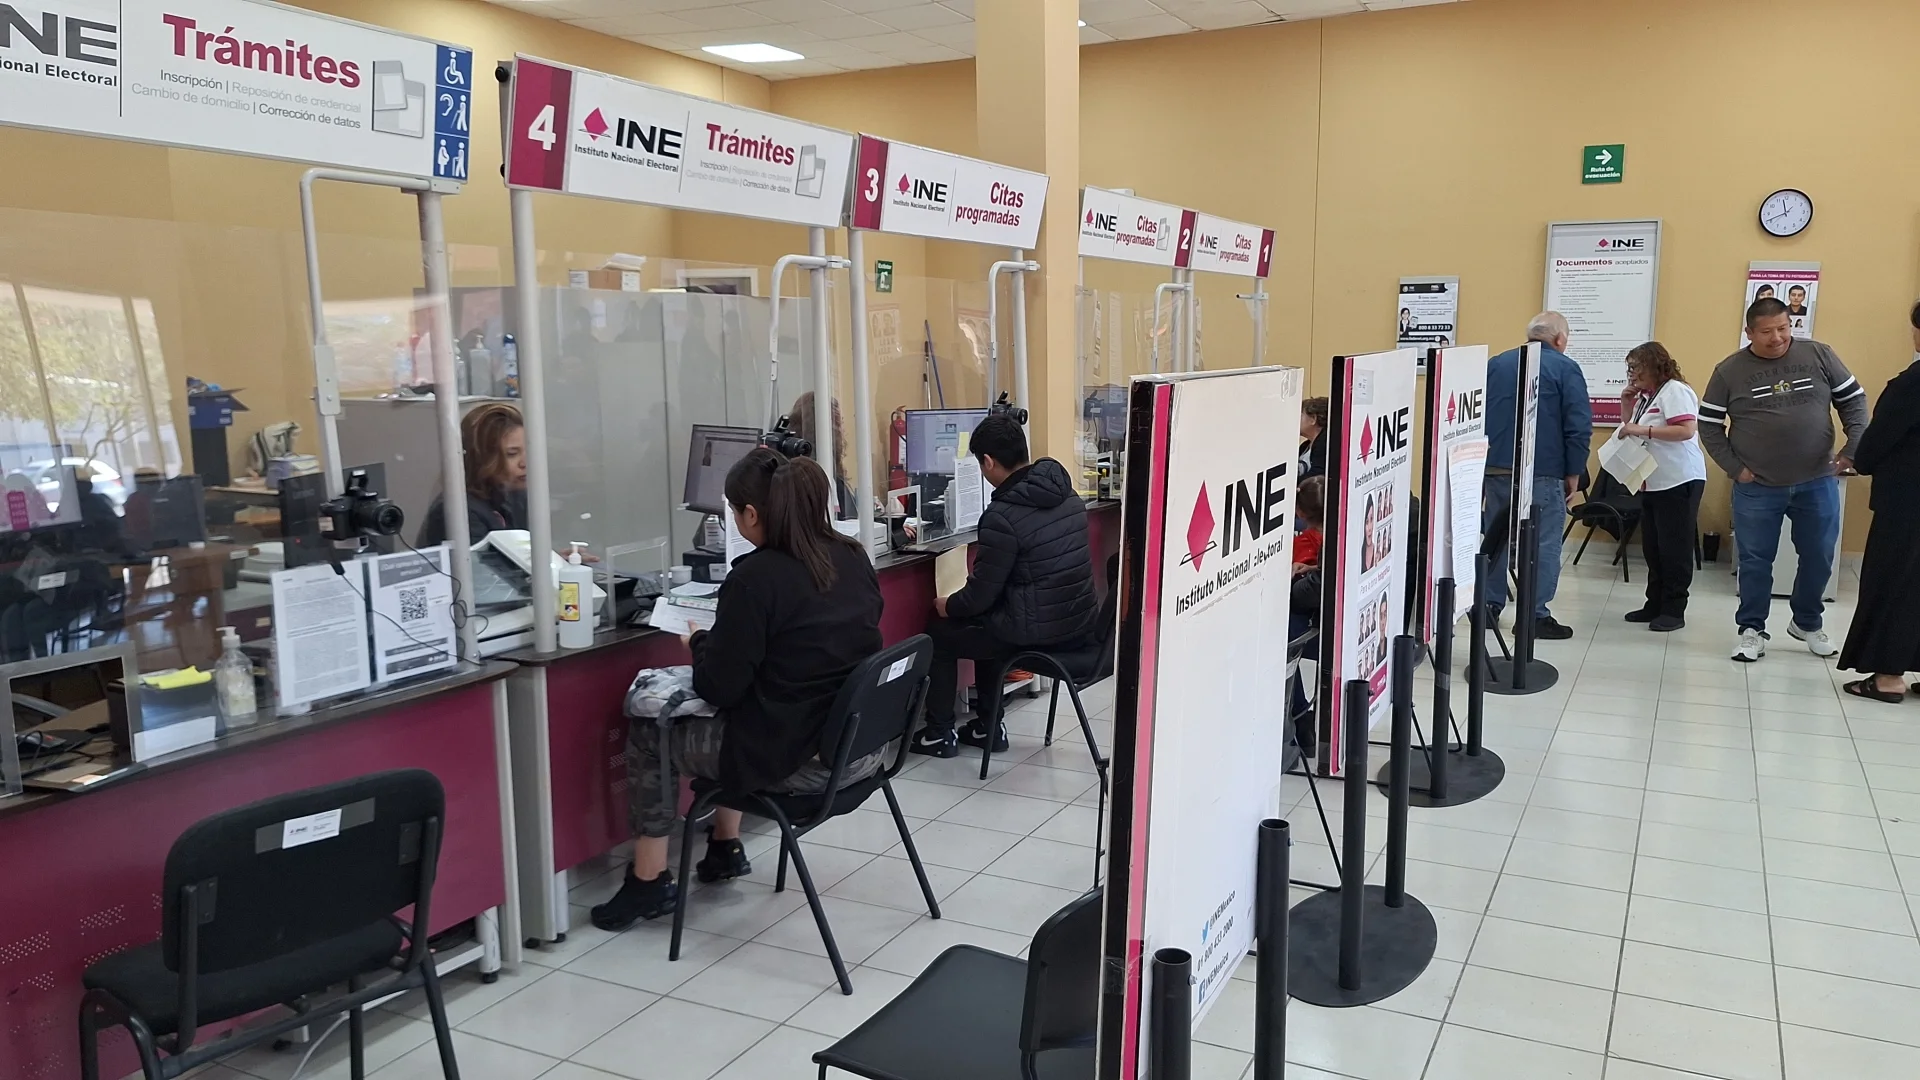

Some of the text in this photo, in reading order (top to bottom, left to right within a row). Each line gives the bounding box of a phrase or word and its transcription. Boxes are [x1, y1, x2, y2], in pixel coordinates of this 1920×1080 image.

[162, 13, 361, 89] Trámites
[45, 63, 117, 87] Electoral
[160, 69, 362, 114] Inscripción Reposición de credencial
[131, 82, 361, 129] Cambio de domicilio Corrección de datos
[528, 104, 557, 151] 4
[616, 117, 683, 160] INE
[706, 122, 796, 166] Trámites
[574, 143, 679, 173] Instituto Nacional Electoral
[864, 167, 880, 202] 3
[912, 178, 948, 203] INE
[990, 181, 1025, 209] Citas
[892, 198, 946, 212] Instituto Nacional Electoral
[955, 204, 1021, 227] programadas
[1094, 212, 1118, 232] INE
[1136, 214, 1158, 234] Citas
[1116, 231, 1156, 247] programadas
[1180, 228, 1191, 250] 2
[1204, 235, 1218, 250] INE
[1234, 233, 1252, 250] Citas
[1612, 238, 1645, 248] INE
[1219, 250, 1250, 263] programadas
[1263, 244, 1270, 263] 1
[1556, 258, 1613, 267] Documentos
[1457, 388, 1482, 424] INE
[1376, 406, 1409, 460] INE
[1221, 461, 1287, 559] INE
[1175, 578, 1215, 616] Instituto
[1215, 552, 1251, 591] Nacional
